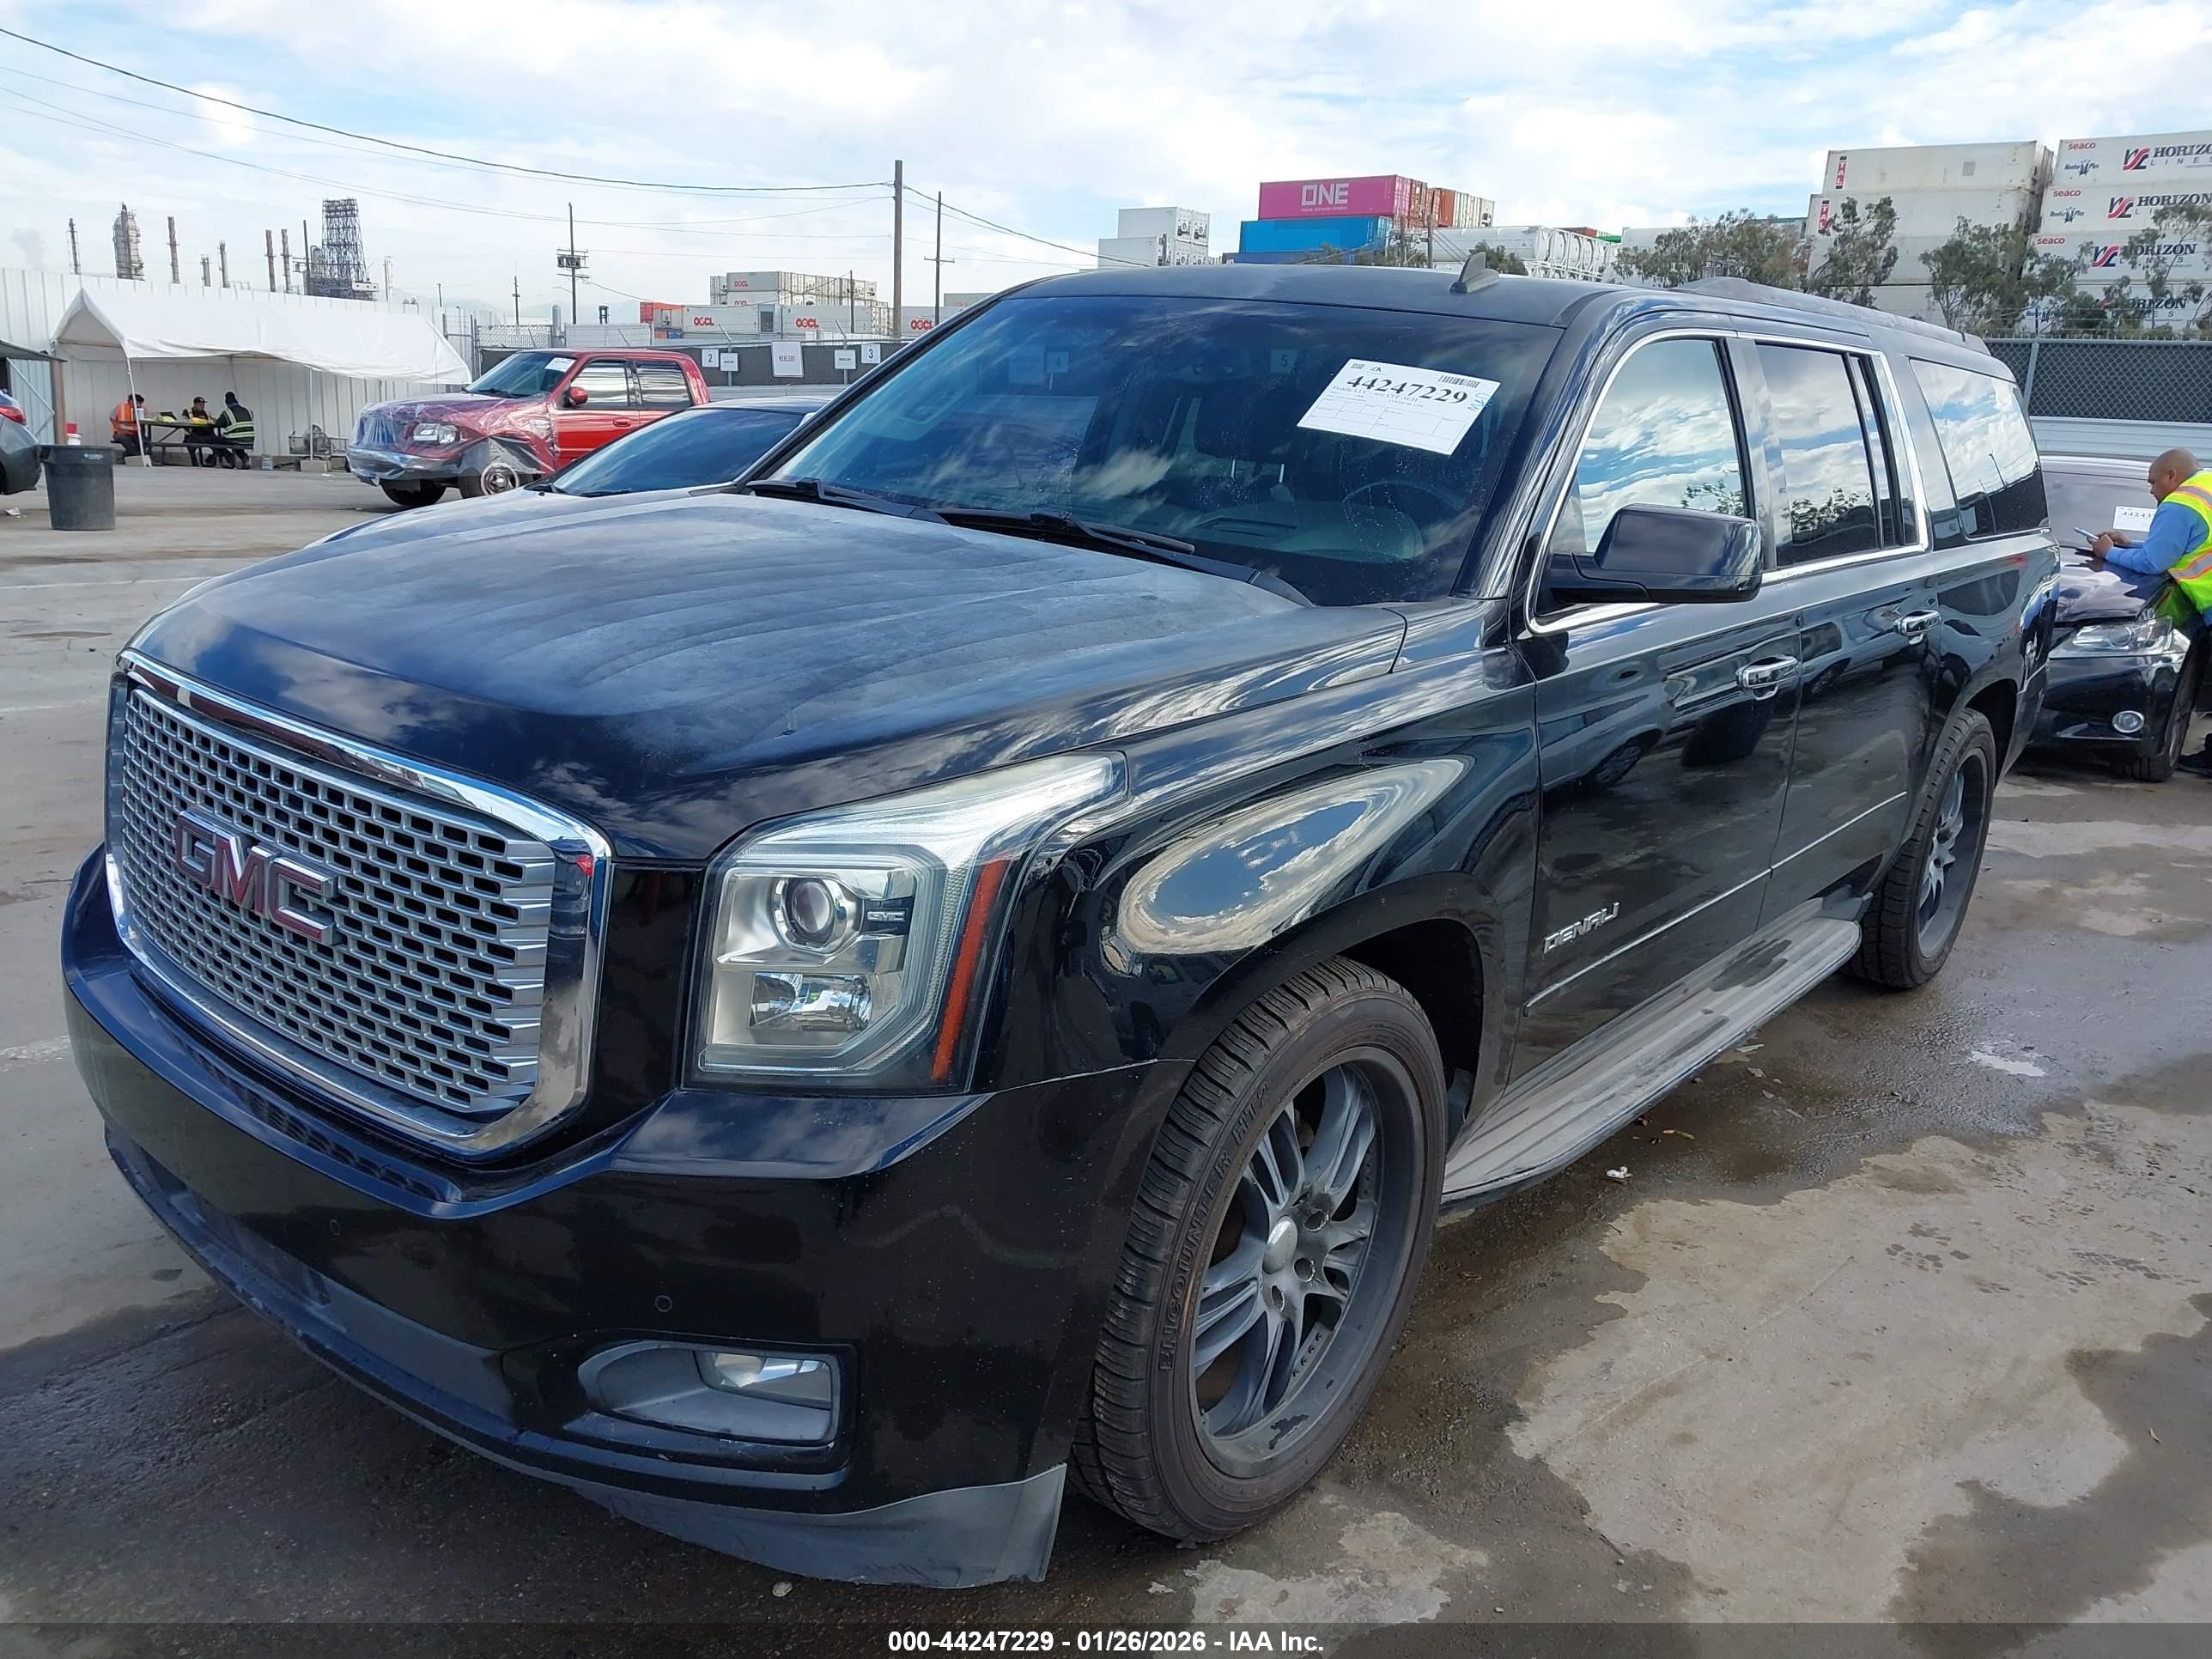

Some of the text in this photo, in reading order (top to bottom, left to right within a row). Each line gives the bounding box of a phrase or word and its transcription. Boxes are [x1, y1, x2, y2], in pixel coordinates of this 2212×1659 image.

[1301, 183, 1349, 206] ONE
[2136, 193, 2212, 206] HORIZON
[2036, 236, 2065, 245] seaco
[694, 317, 714, 326] OOCL
[795, 318, 819, 328] OOCL
[708, 353, 714, 363] 2
[868, 349, 874, 359] 3
[1054, 356, 1061, 368] 4
[1281, 354, 1288, 368] 5
[1346, 375, 1468, 404] 44247229
[174, 810, 340, 945] GMC
[867, 911, 906, 922] GMC
[1158, 1151, 1232, 1372] ENCOUNTER
